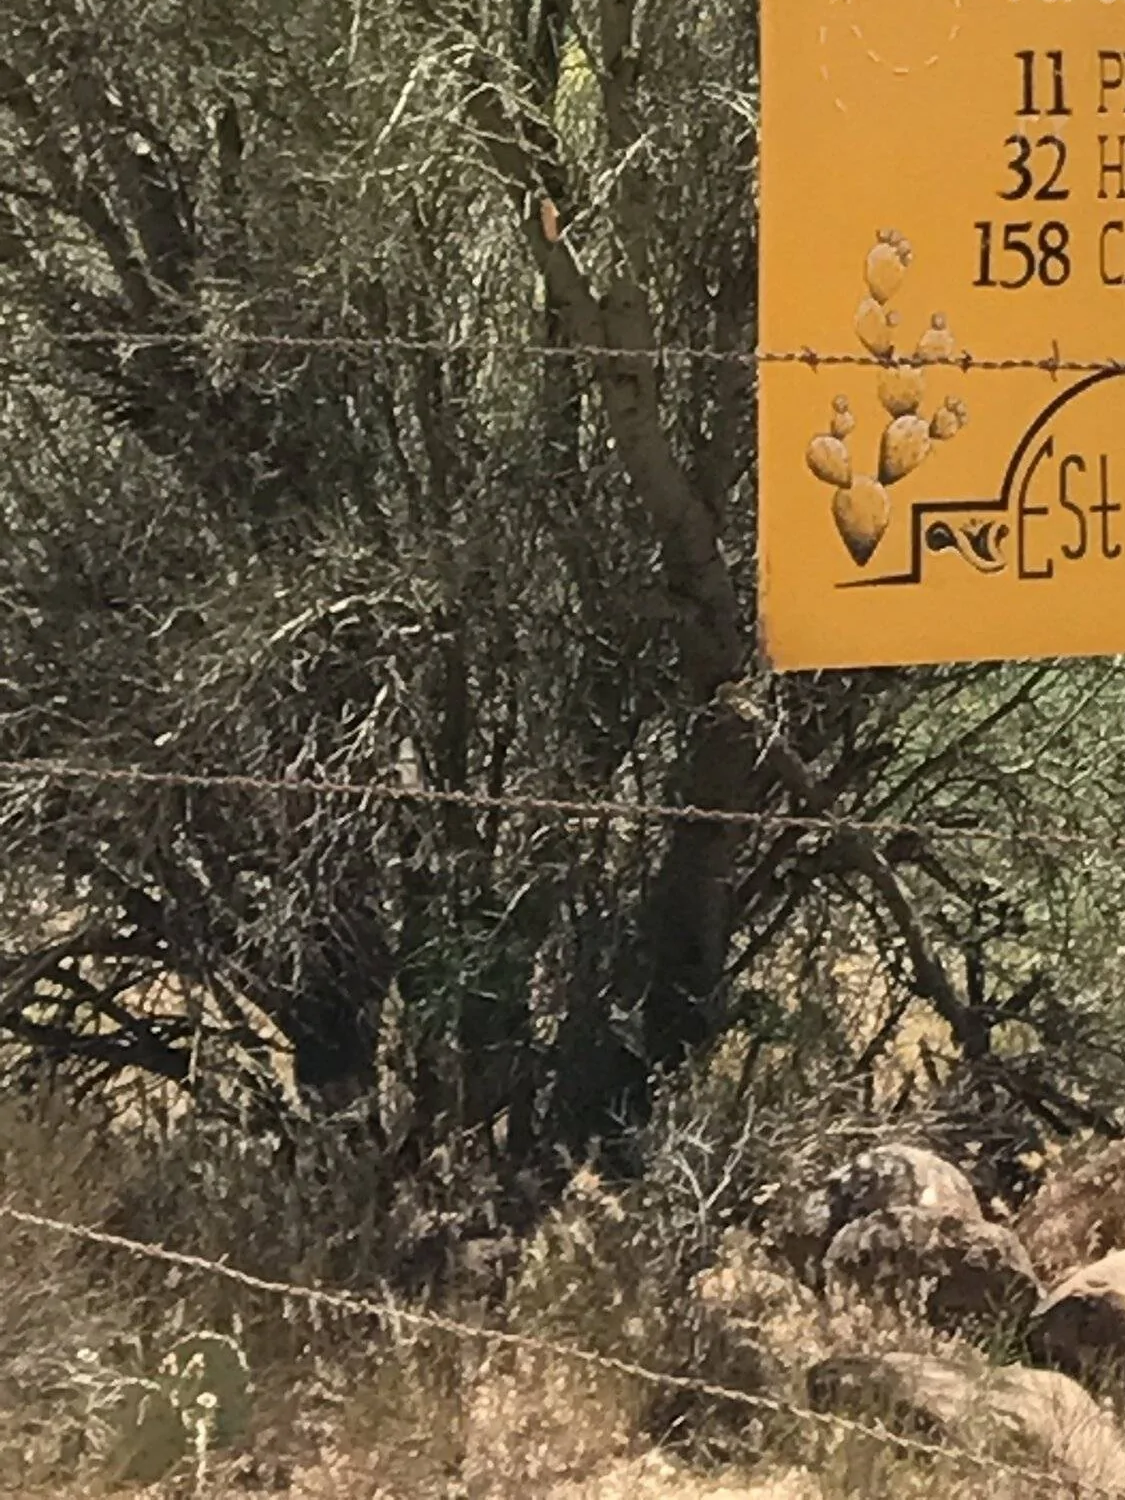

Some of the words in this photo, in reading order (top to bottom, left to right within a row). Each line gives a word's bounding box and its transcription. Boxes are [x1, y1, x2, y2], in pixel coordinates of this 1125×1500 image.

[1014, 49, 1072, 116] 11
[996, 135, 1071, 200] 32
[972, 220, 1072, 289] 158
